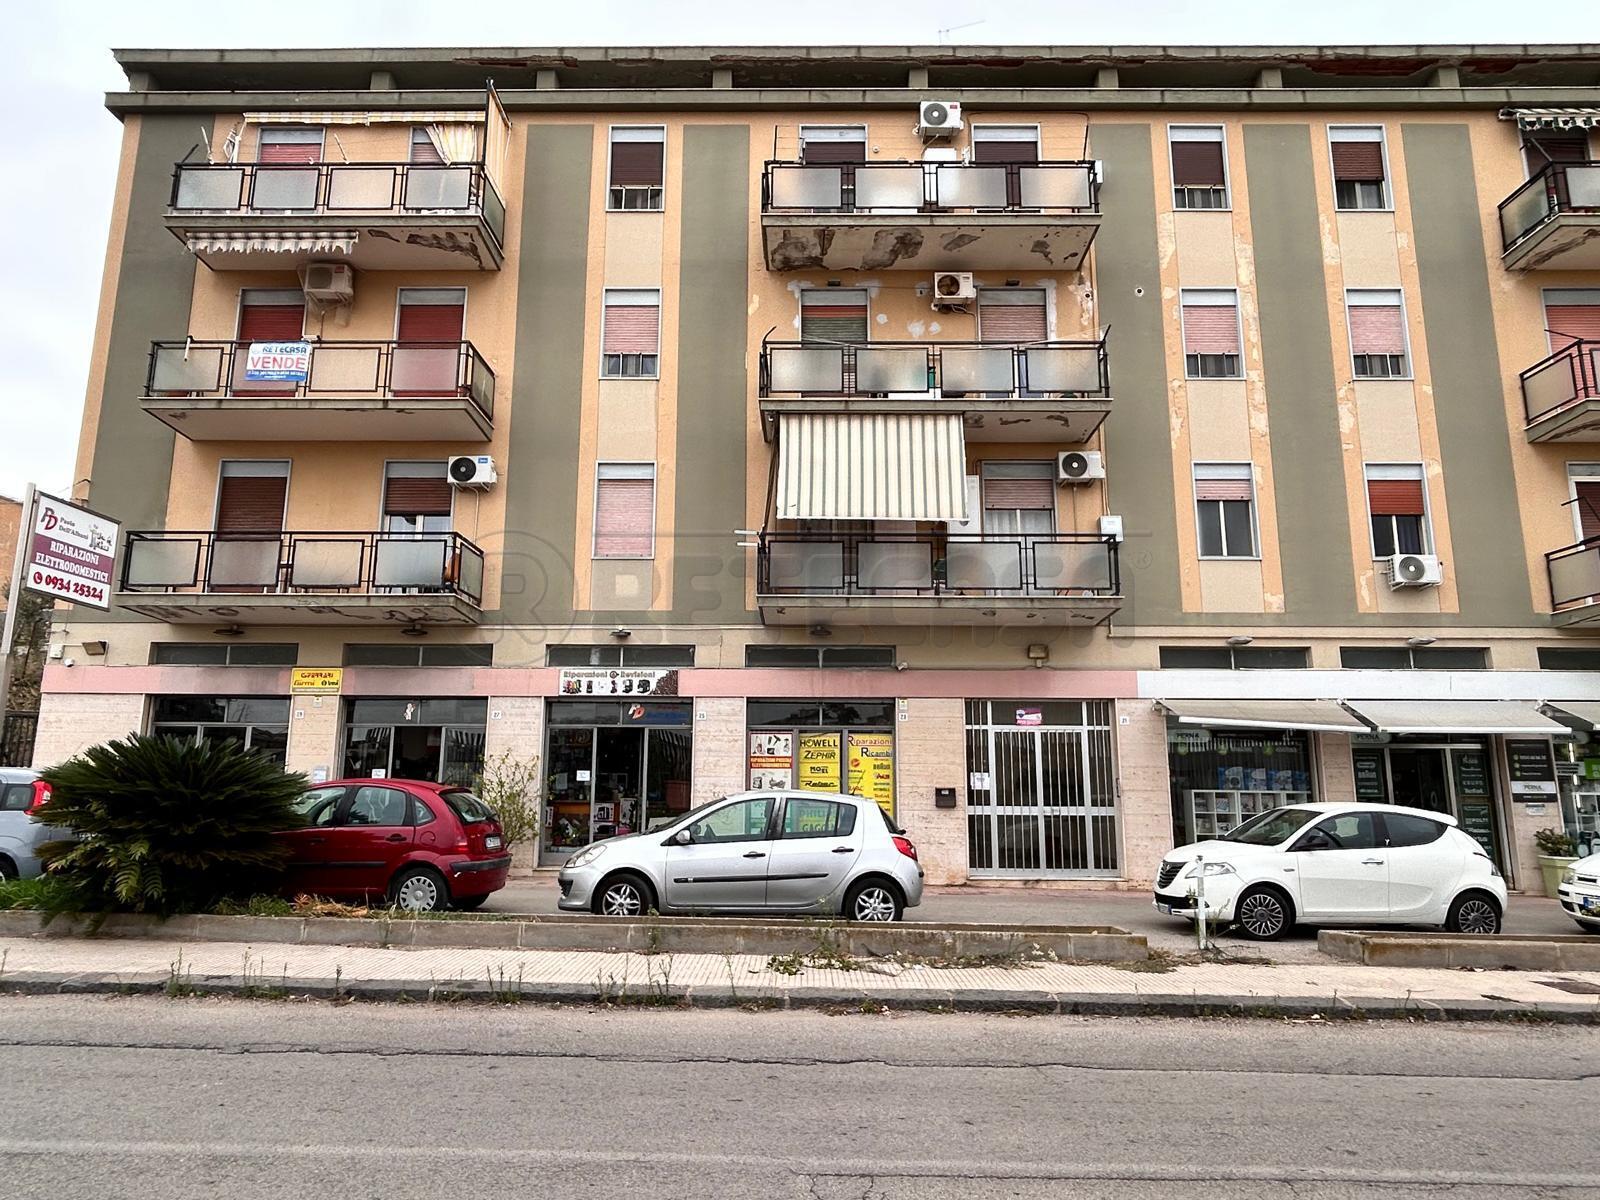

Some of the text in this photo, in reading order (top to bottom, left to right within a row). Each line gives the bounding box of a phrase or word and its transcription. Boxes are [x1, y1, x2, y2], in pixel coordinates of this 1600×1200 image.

[263, 346, 307, 354] RETECASA
[251, 356, 307, 370] VENDE
[50, 541, 99, 565] RIPARAZIONI
[35, 552, 109, 583] ELETTRODOMESTICI
[45, 574, 104, 602] 0934 25324
[800, 738, 838, 748] HOWELL
[848, 735, 893, 747] Riparazioni
[804, 750, 836, 760] ZEPHIR
[861, 747, 893, 757] Ricambi
